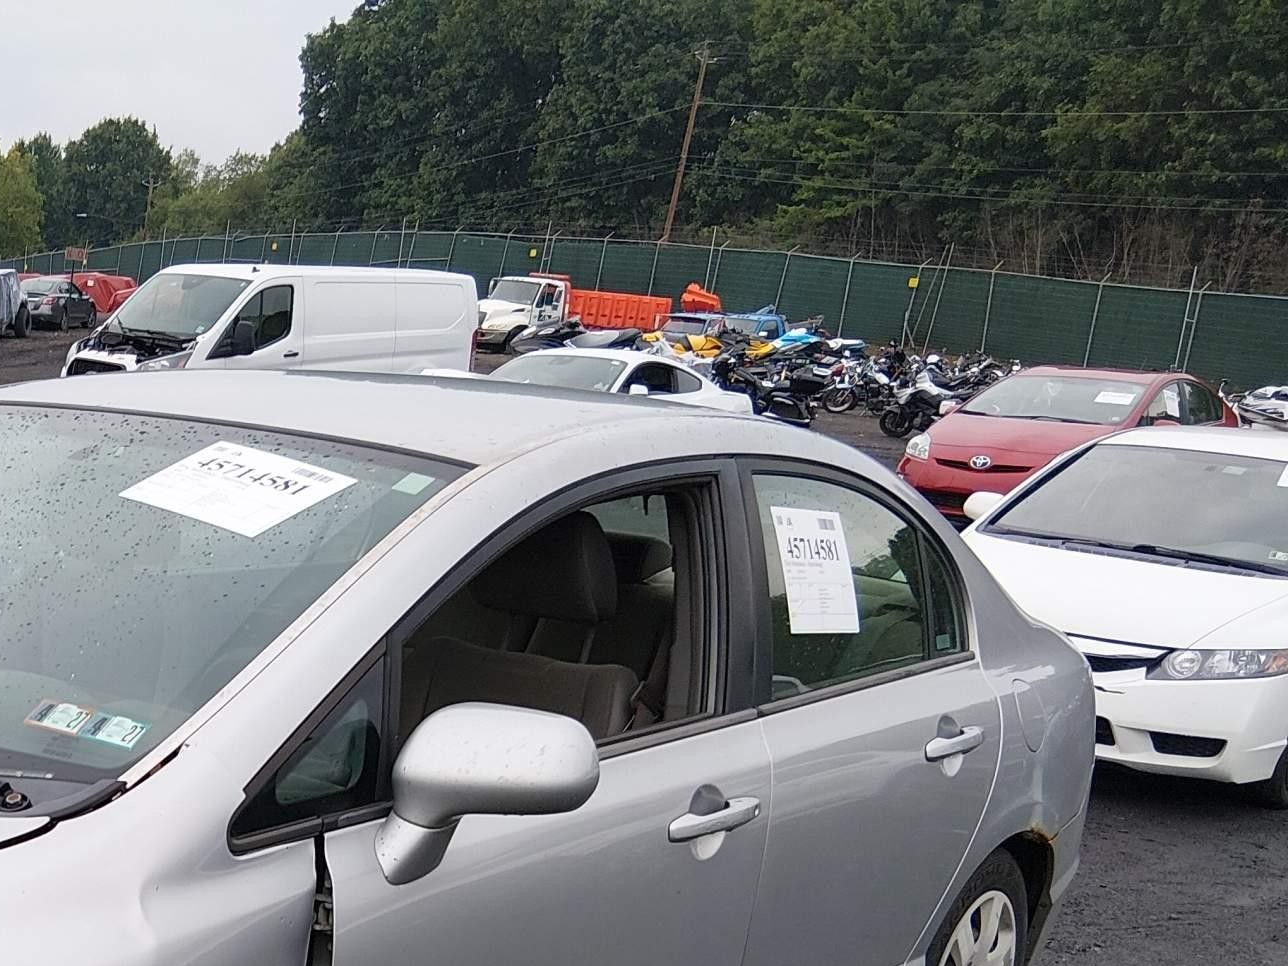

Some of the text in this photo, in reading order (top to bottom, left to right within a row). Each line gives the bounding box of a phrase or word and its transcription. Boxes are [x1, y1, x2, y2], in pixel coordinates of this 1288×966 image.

[197, 458, 310, 495] 45714581
[786, 536, 840, 561] 45714581
[66, 711, 90, 730] 27
[121, 725, 144, 744] 27
